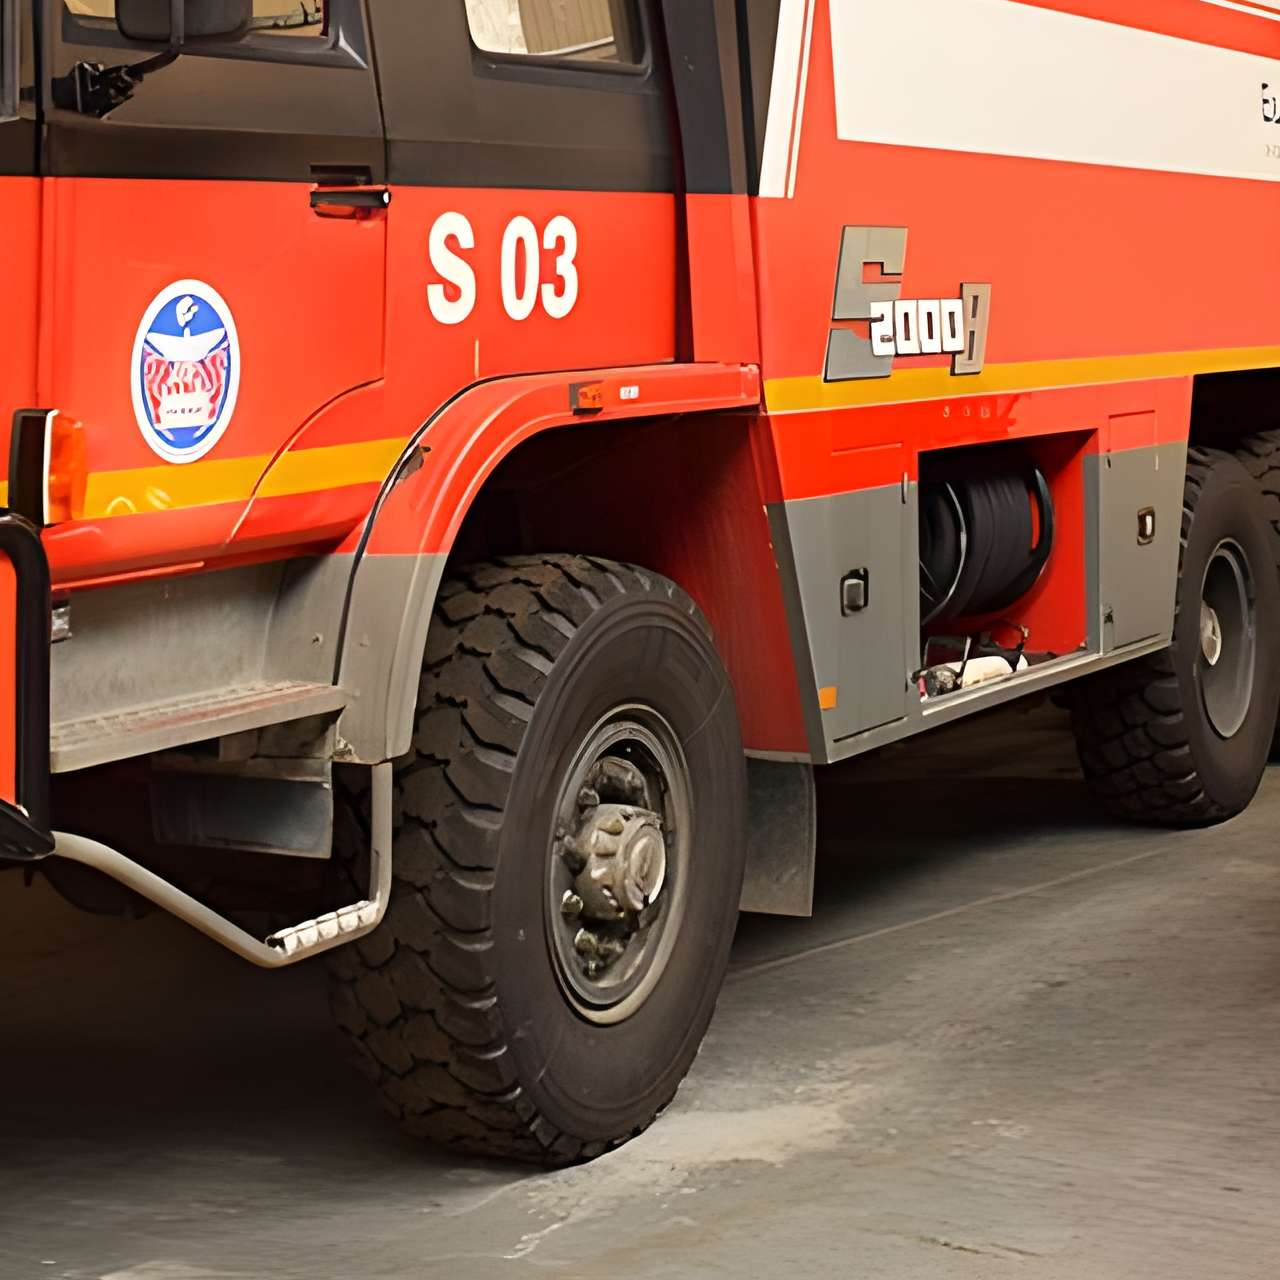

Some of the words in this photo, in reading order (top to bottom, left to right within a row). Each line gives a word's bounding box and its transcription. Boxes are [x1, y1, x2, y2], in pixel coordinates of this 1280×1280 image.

[426, 211, 477, 325] S
[500, 215, 579, 320] 03
[869, 298, 965, 357] 2000
